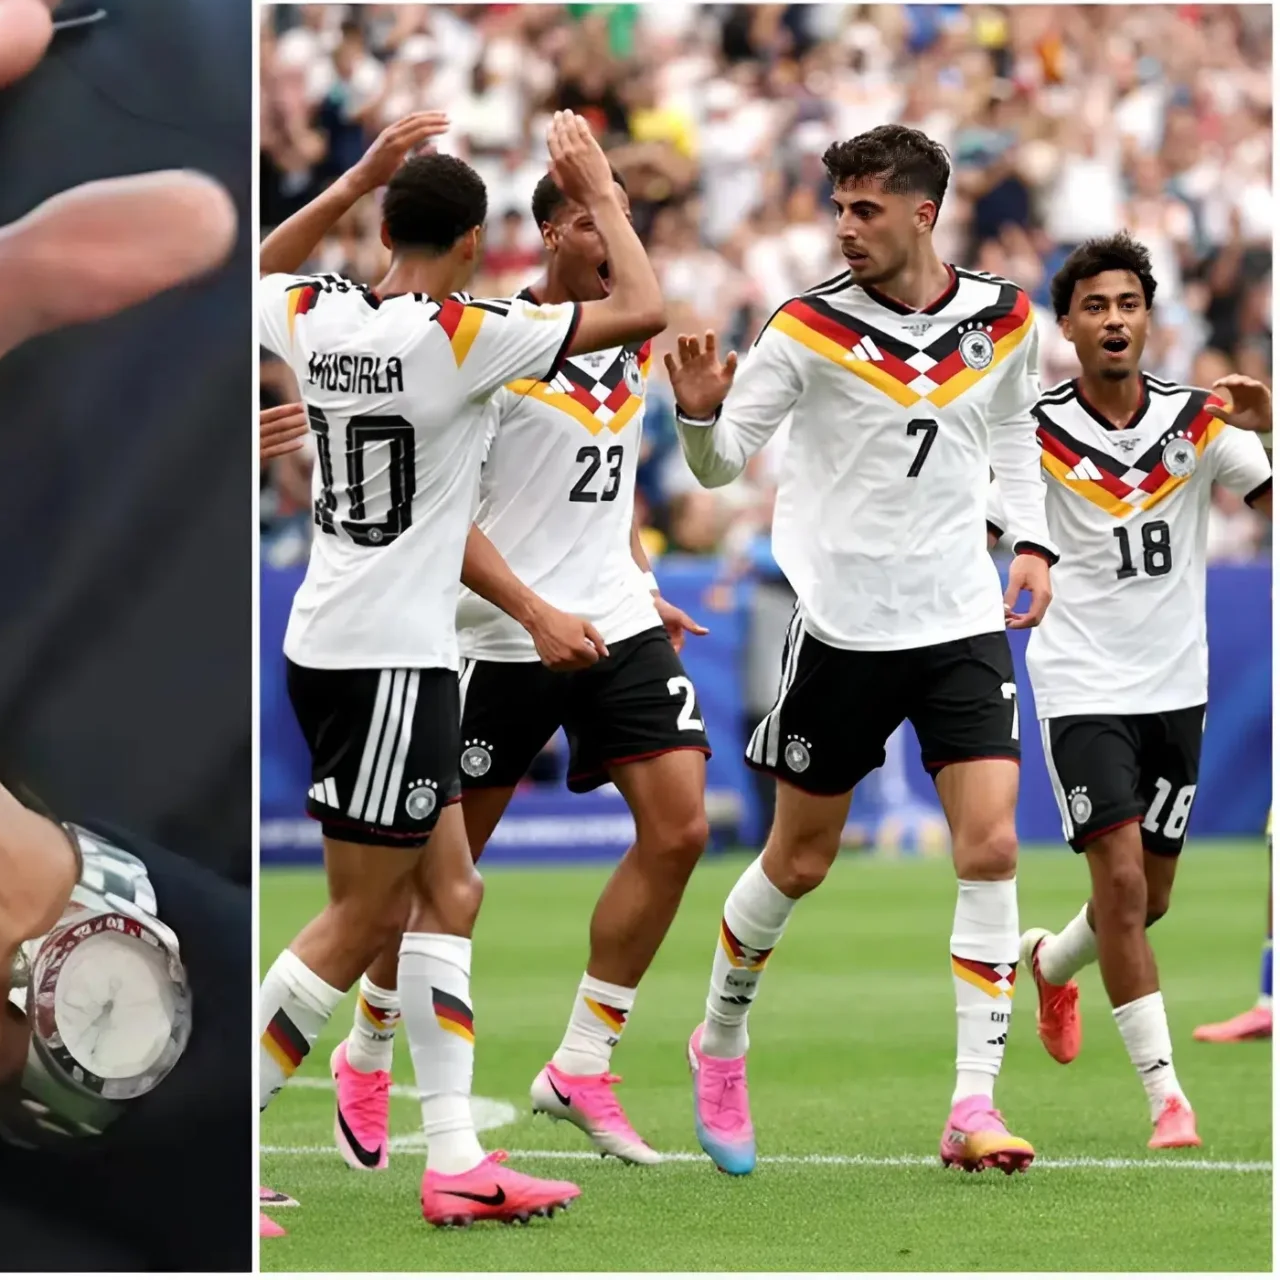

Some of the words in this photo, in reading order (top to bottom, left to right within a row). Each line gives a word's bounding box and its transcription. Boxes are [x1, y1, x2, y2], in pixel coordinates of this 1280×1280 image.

[307, 404, 416, 547] 10
[569, 445, 624, 503] 23
[907, 418, 939, 478] 7
[1113, 520, 1172, 580] 18
[666, 675, 706, 732] 2
[1141, 776, 1197, 839] 18
